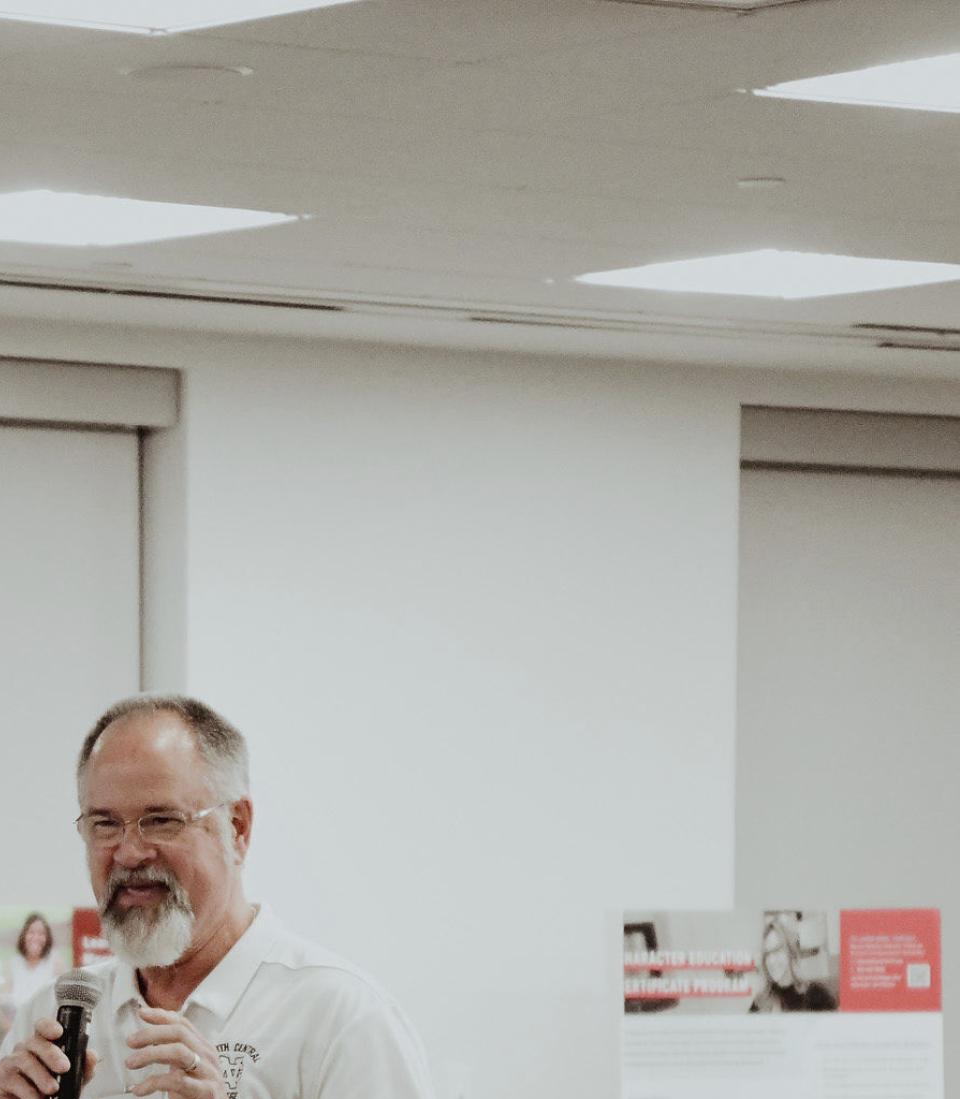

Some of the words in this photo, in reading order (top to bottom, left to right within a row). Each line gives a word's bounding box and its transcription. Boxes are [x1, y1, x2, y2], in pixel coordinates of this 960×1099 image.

[624, 951, 687, 966] HARACTER
[624, 978, 683, 993] ERTIFICATE
[234, 1042, 261, 1063] CENTRAL
